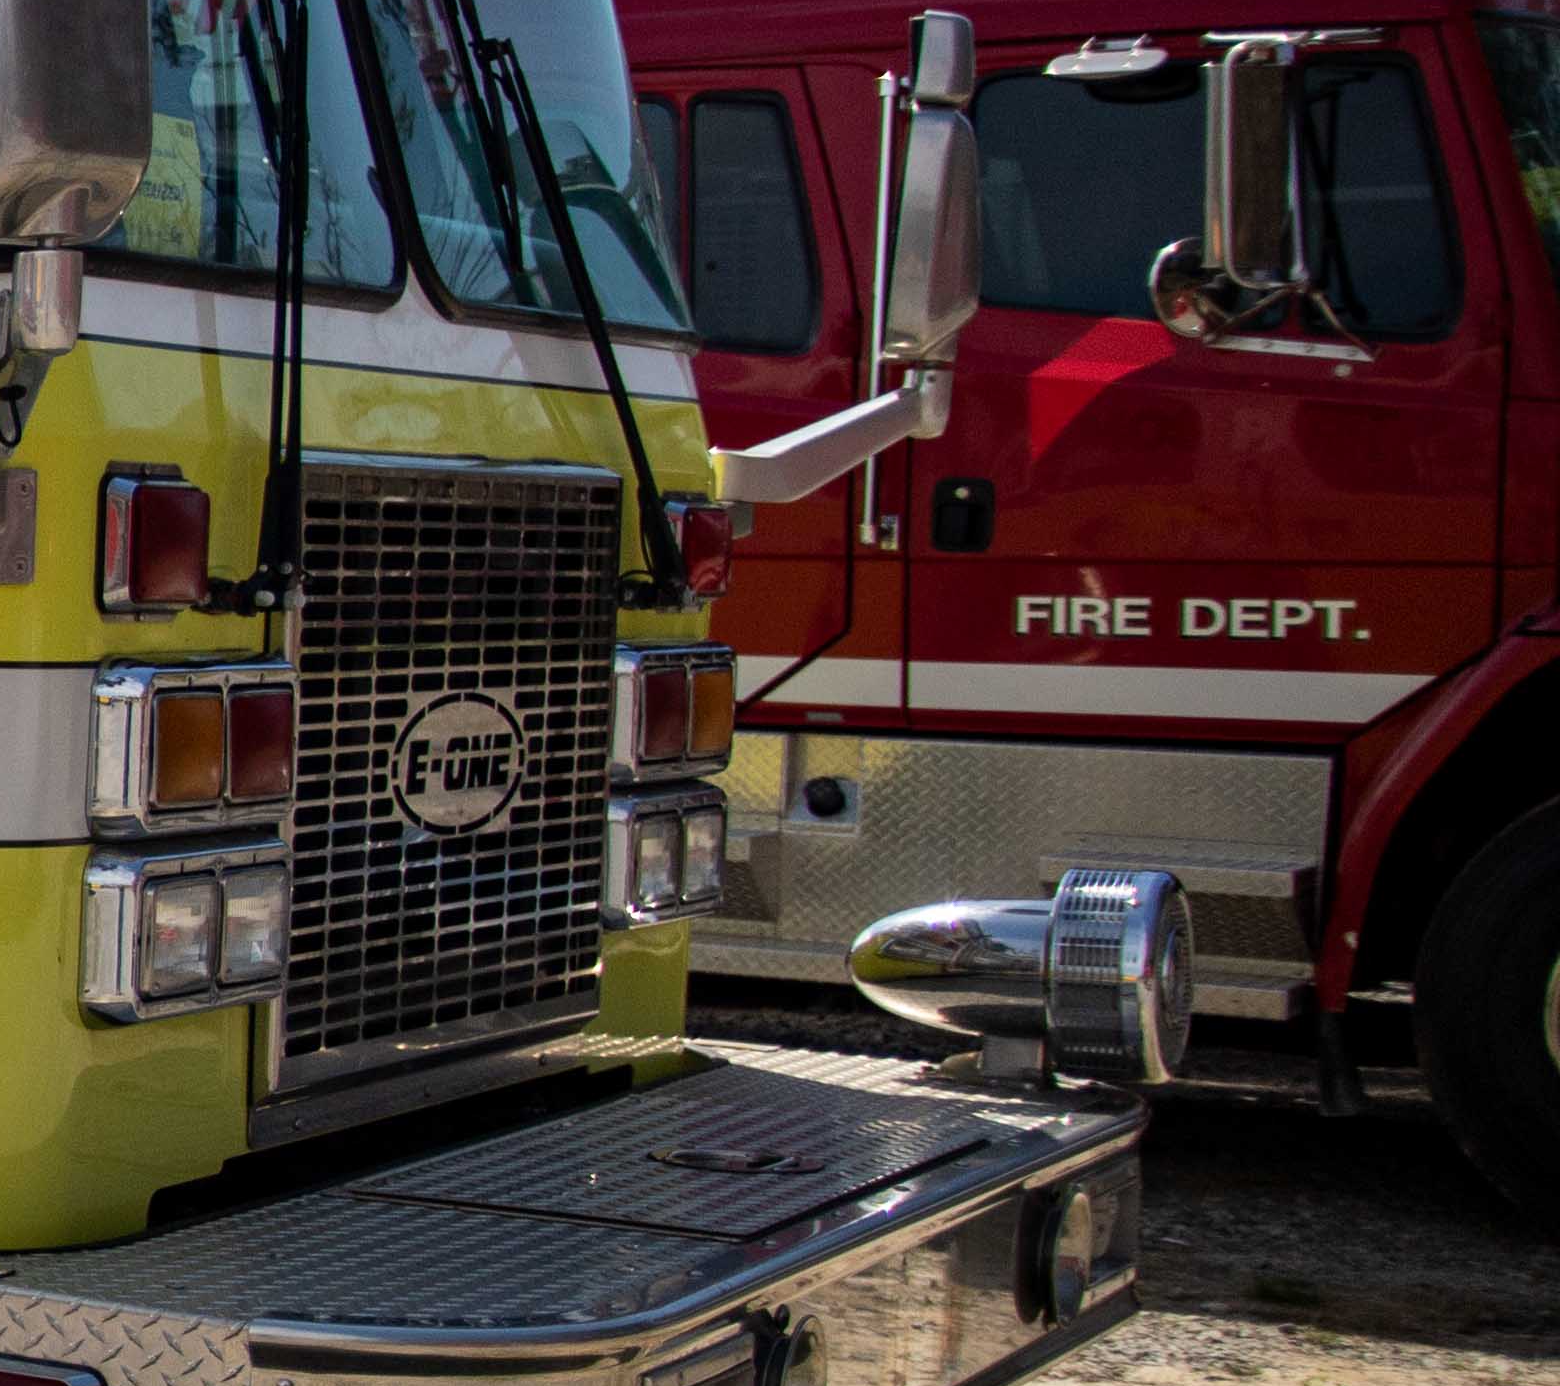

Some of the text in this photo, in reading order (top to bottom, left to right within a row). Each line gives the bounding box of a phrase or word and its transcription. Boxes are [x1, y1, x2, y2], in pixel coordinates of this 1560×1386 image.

[1015, 595, 1371, 641] FIRE DEPT.
[405, 732, 513, 796] E-ONE
